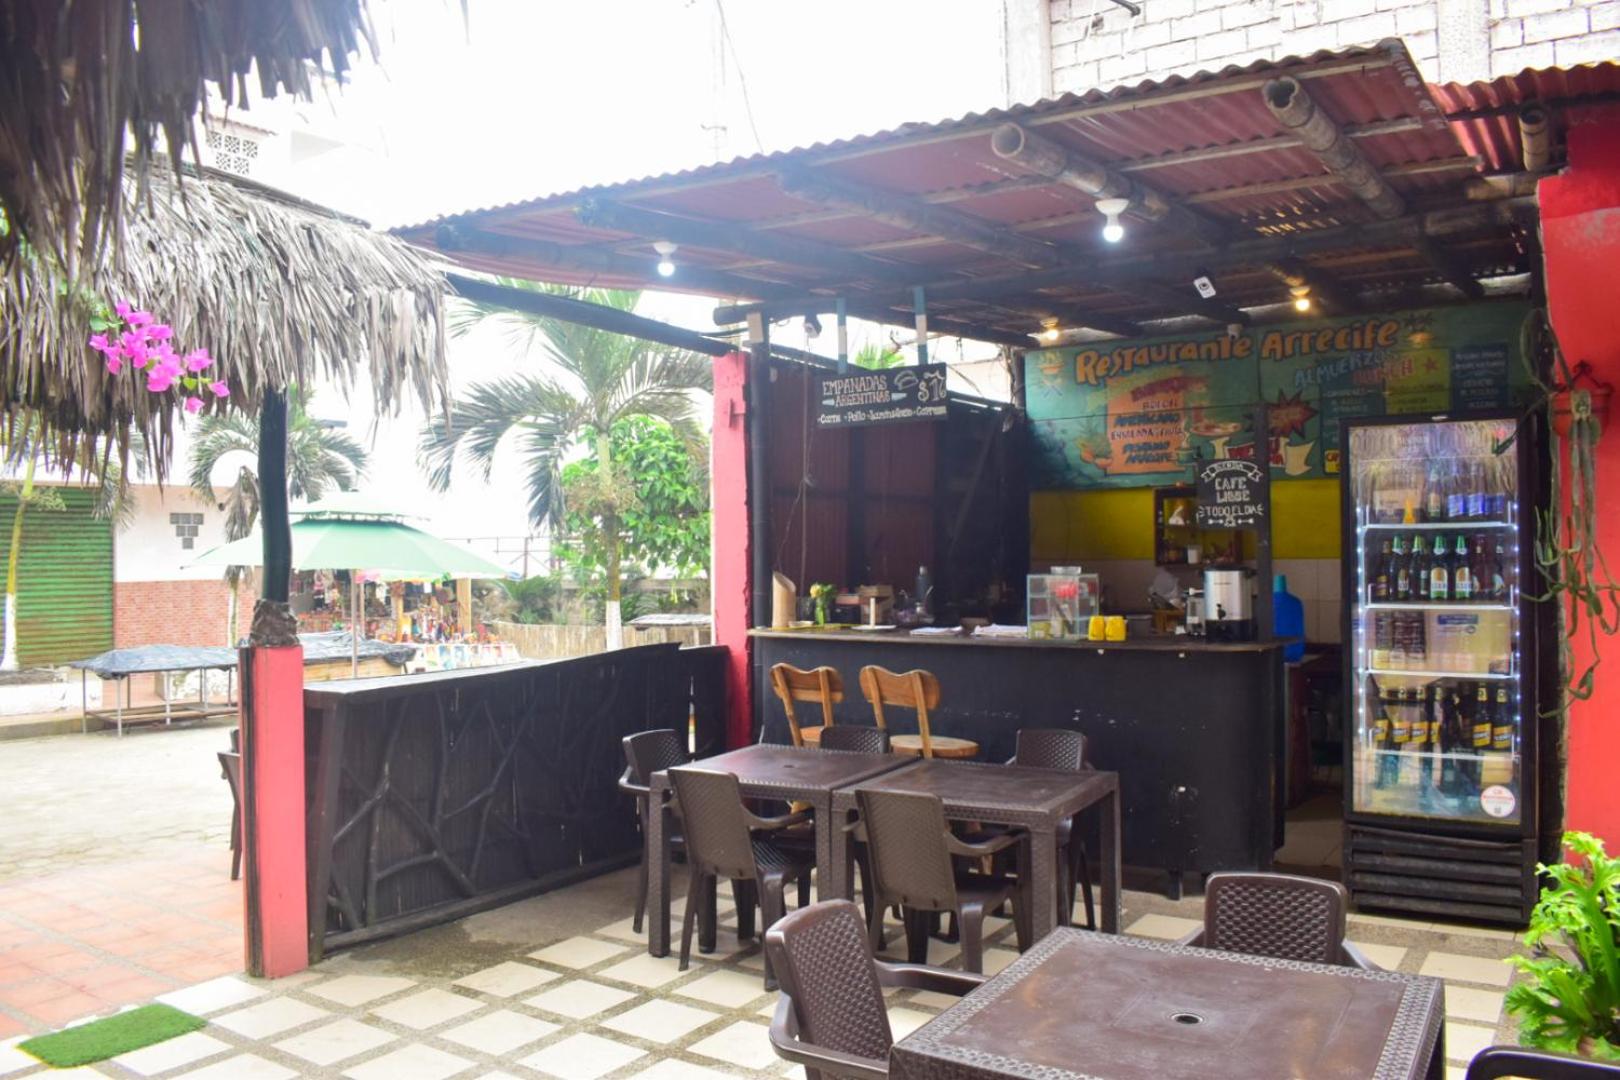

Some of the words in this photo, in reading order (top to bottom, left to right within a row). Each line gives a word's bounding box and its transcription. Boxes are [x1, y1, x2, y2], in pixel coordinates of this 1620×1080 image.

[1075, 335, 1252, 385] Restaurante
[1261, 319, 1399, 361] Arrecife
[822, 374, 888, 396] EMPANADAS
[835, 390, 892, 407] ARGENTINAS
